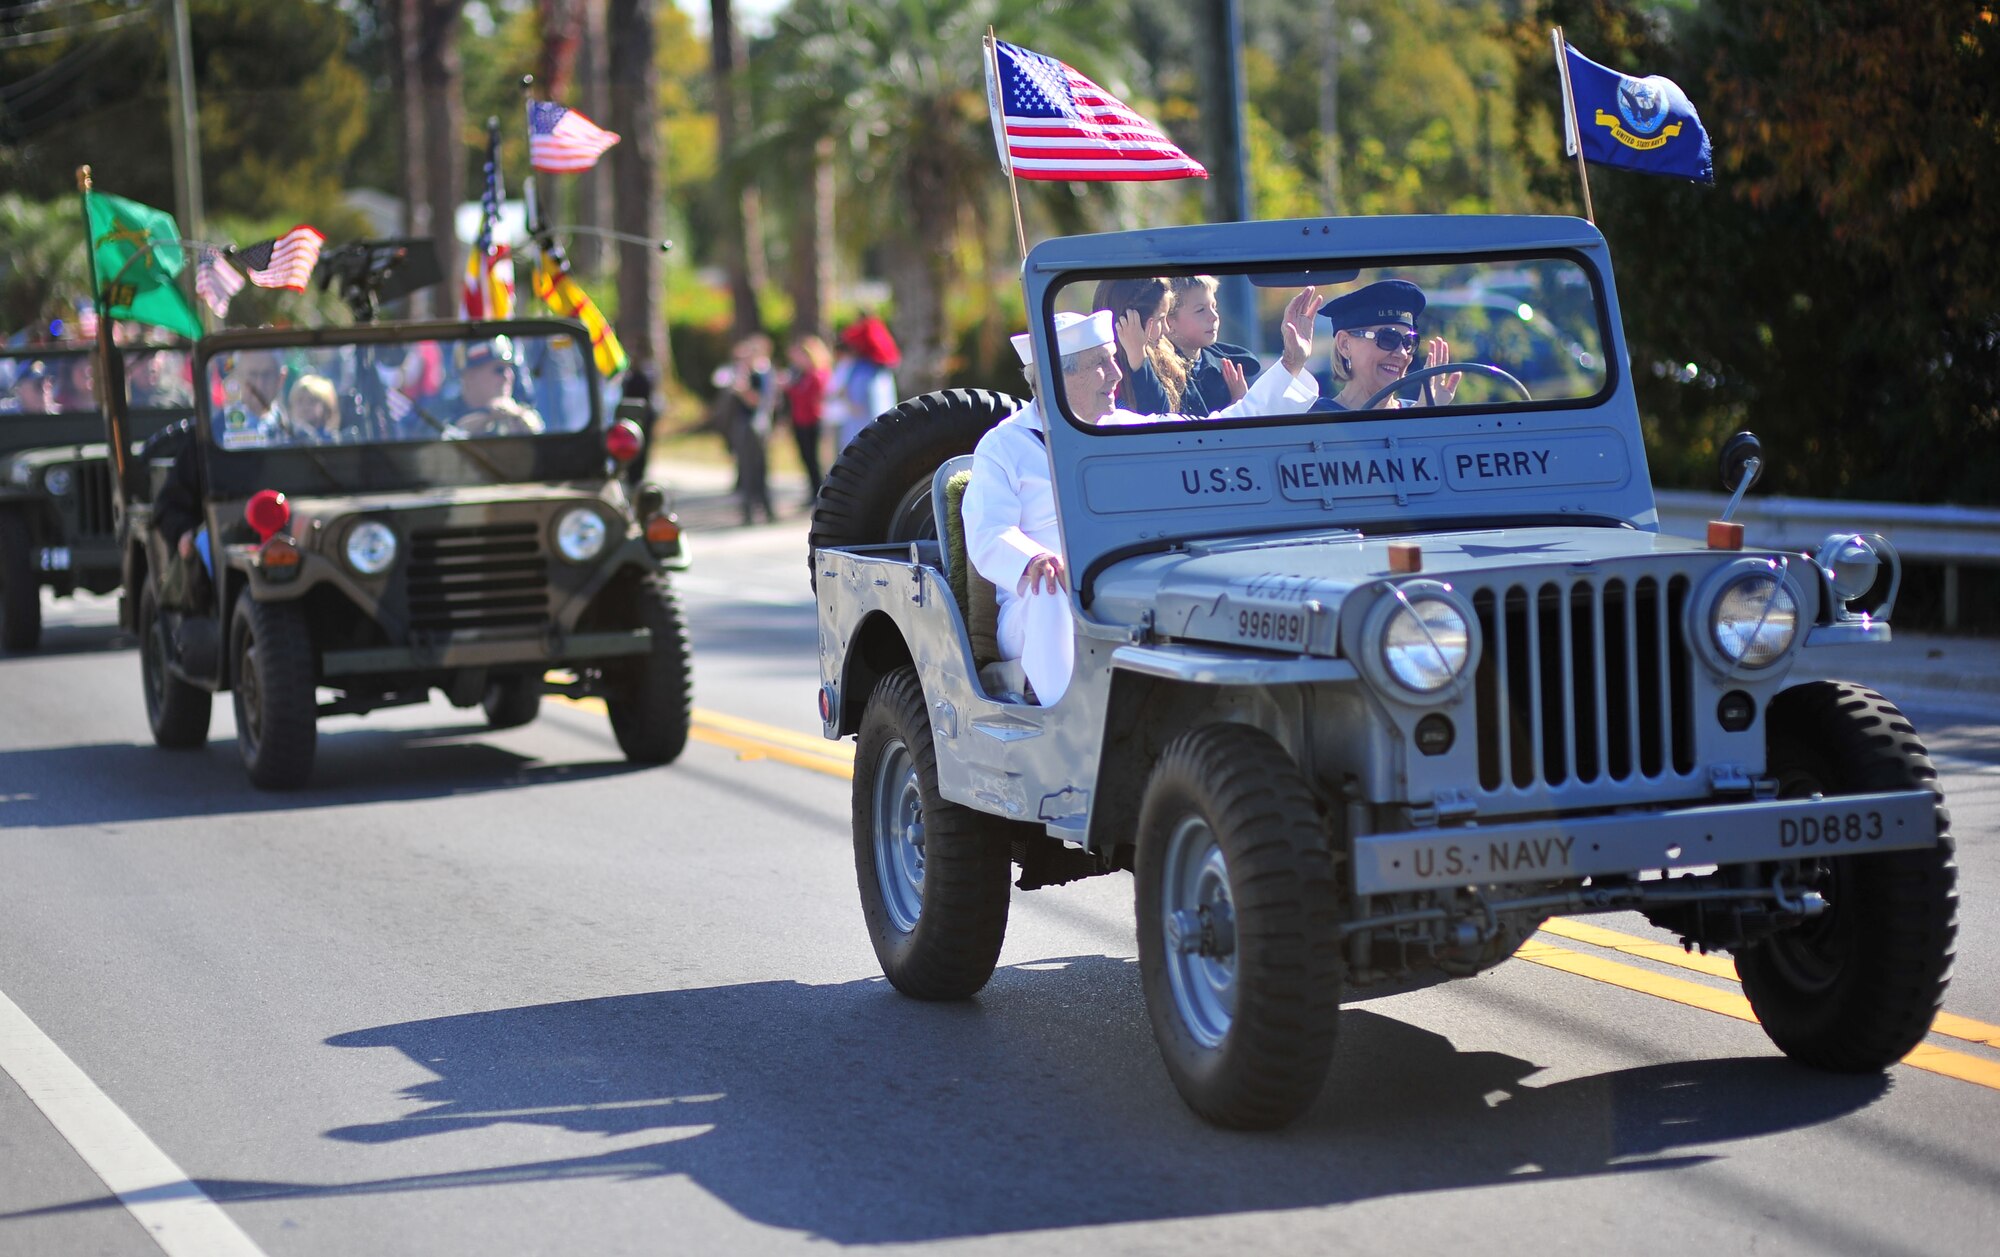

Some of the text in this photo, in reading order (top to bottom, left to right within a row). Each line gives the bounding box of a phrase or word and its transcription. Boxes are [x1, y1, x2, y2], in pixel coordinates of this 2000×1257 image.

[1616, 130, 1635, 144] UNITED
[1181, 450, 1551, 495] U.S.S. NEWMAN K. PERRY
[1237, 609, 1306, 645] 9961891
[1779, 811, 1884, 849] DD883
[1414, 836, 1576, 878] U.S. NAVY
